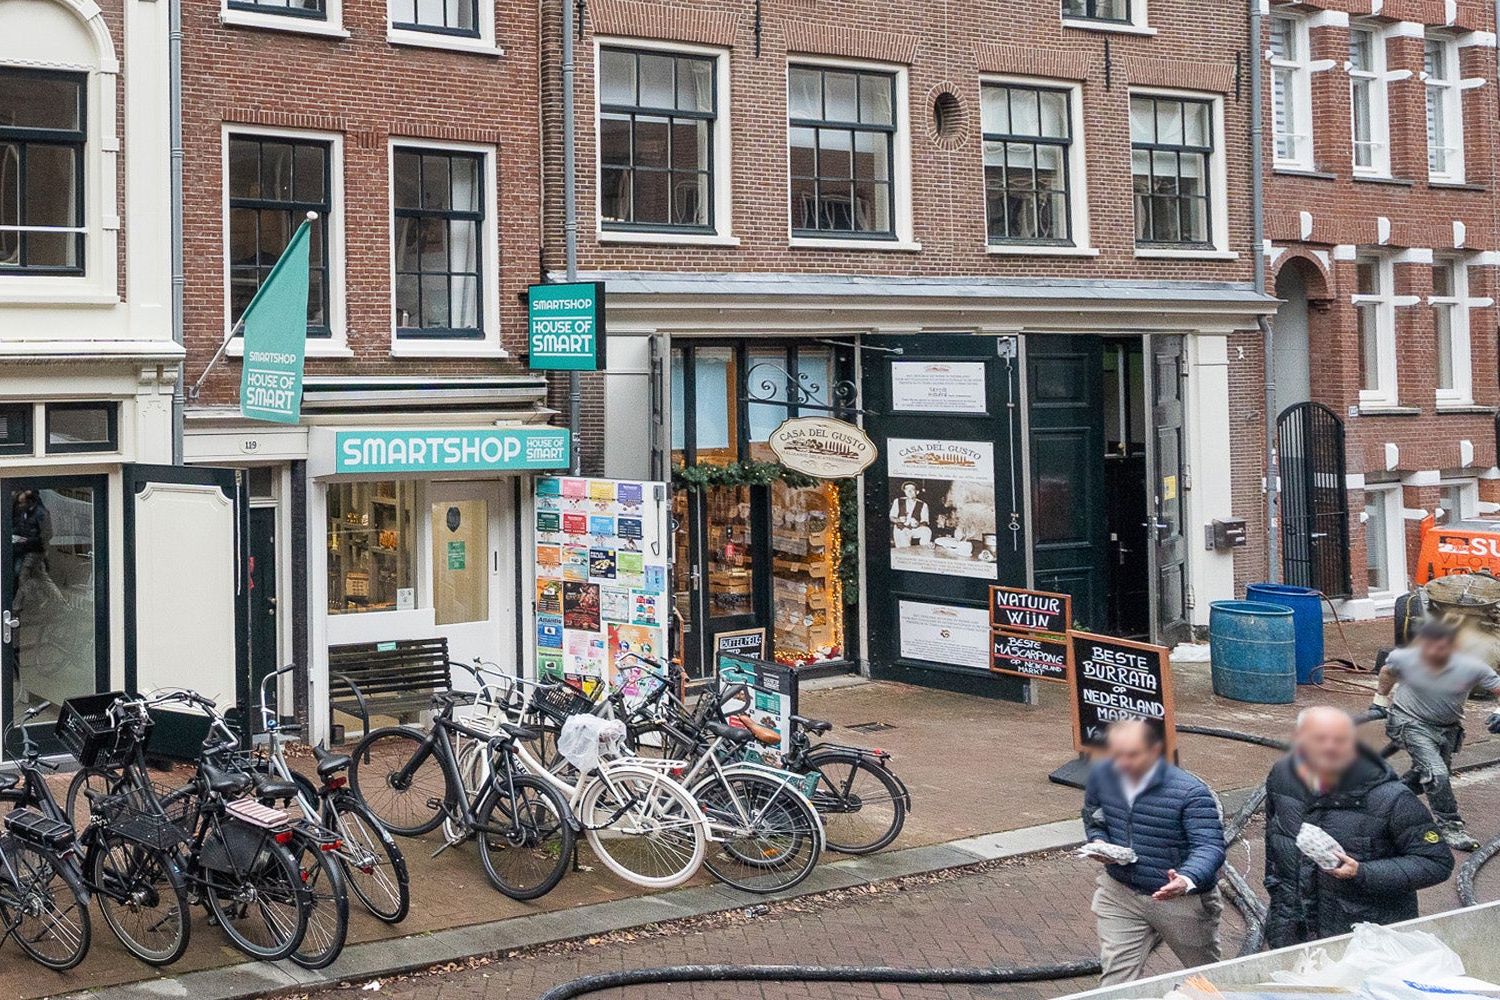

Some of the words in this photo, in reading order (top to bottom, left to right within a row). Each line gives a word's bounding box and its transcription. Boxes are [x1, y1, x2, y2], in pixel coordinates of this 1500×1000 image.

[532, 299, 592, 310] SMARTSHOP
[533, 321, 571, 333] HOUSE
[574, 321, 592, 333] OF
[533, 335, 592, 352] SMART
[249, 351, 296, 364] SMARTSHOP
[247, 373, 278, 388] HOUSE
[280, 376, 295, 389] OF
[246, 387, 295, 409] SMART
[245, 441, 257, 450] 119
[526, 439, 551, 448] HOUSE
[552, 439, 564, 447] OF
[780, 429, 806, 441] CASA
[809, 429, 828, 438] DEL
[831, 431, 866, 451] GUSTO
[343, 437, 521, 465] SMARTSHOP
[526, 448, 564, 459] SMART
[899, 445, 924, 457] CASA
[947, 445, 981, 460] GUSTO
[997, 591, 1060, 613] NATUUR
[1008, 637, 1041, 649] BESTE
[994, 643, 1064, 664] MASCARPONE
[1092, 647, 1148, 669] BESTE
[1010, 658, 1021, 666] OP
[1018, 666, 1045, 676] MARKT
[1083, 660, 1157, 690] BURRATA
[1112, 685, 1127, 693] OP
[1083, 689, 1165, 716] NEDERLAND
